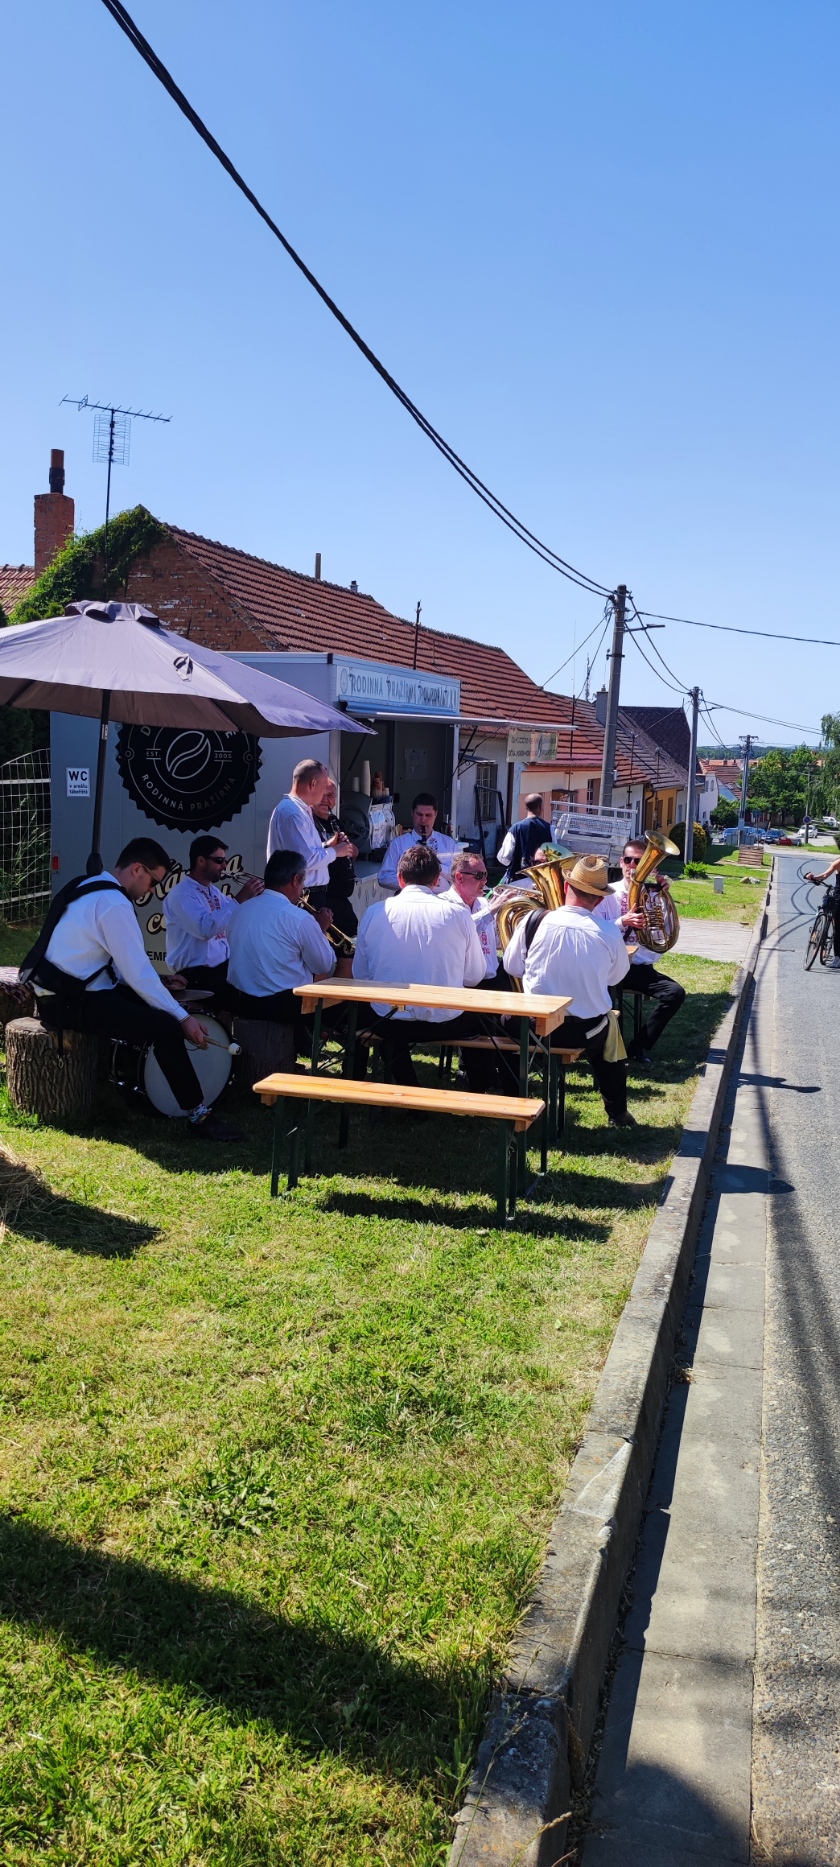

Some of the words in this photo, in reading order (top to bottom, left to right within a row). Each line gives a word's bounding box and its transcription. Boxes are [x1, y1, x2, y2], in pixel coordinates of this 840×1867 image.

[69, 771, 88, 781] WC
[142, 774, 184, 811] RODINNÁ
[190, 777, 236, 811] PRAŽÍRNA
